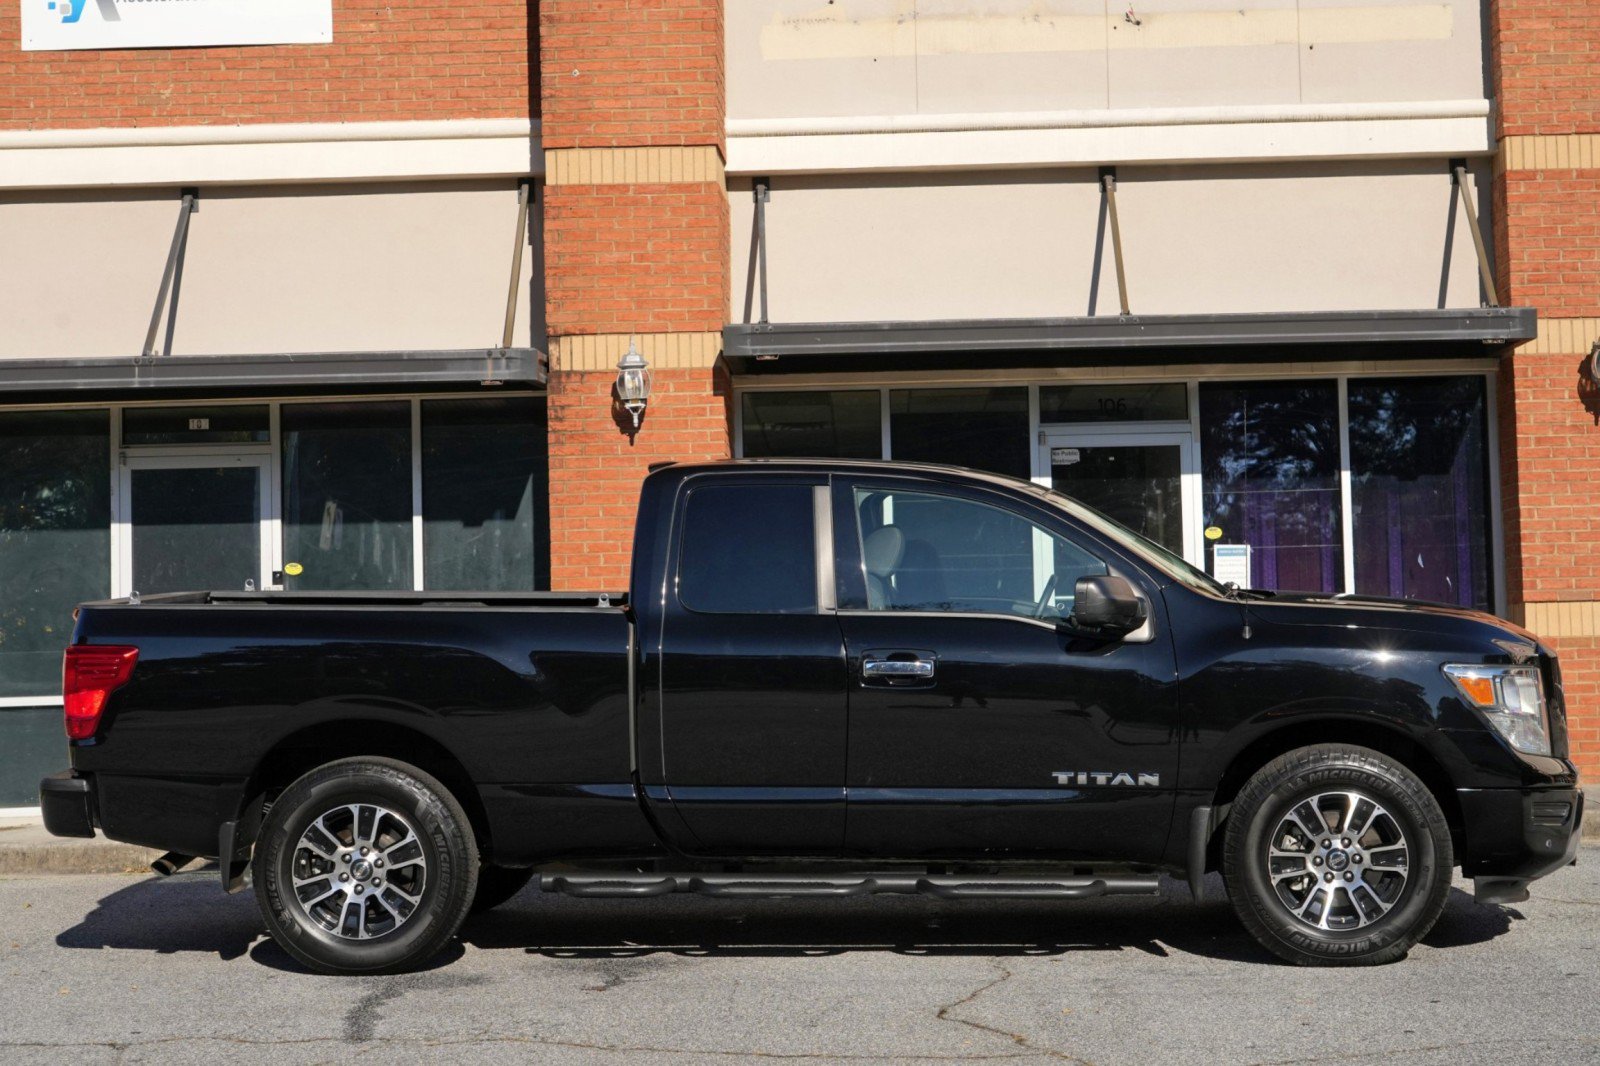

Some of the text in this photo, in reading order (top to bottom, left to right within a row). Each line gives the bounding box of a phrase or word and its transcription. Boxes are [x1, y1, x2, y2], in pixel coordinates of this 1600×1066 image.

[1098, 398, 1128, 416] 106
[1051, 771, 1160, 786] TITAN
[1309, 769, 1387, 790] MICHELIN
[266, 833, 284, 911] MICHELIN
[433, 833, 451, 913] MICHELIN
[1289, 932, 1371, 954] MICHELIN
